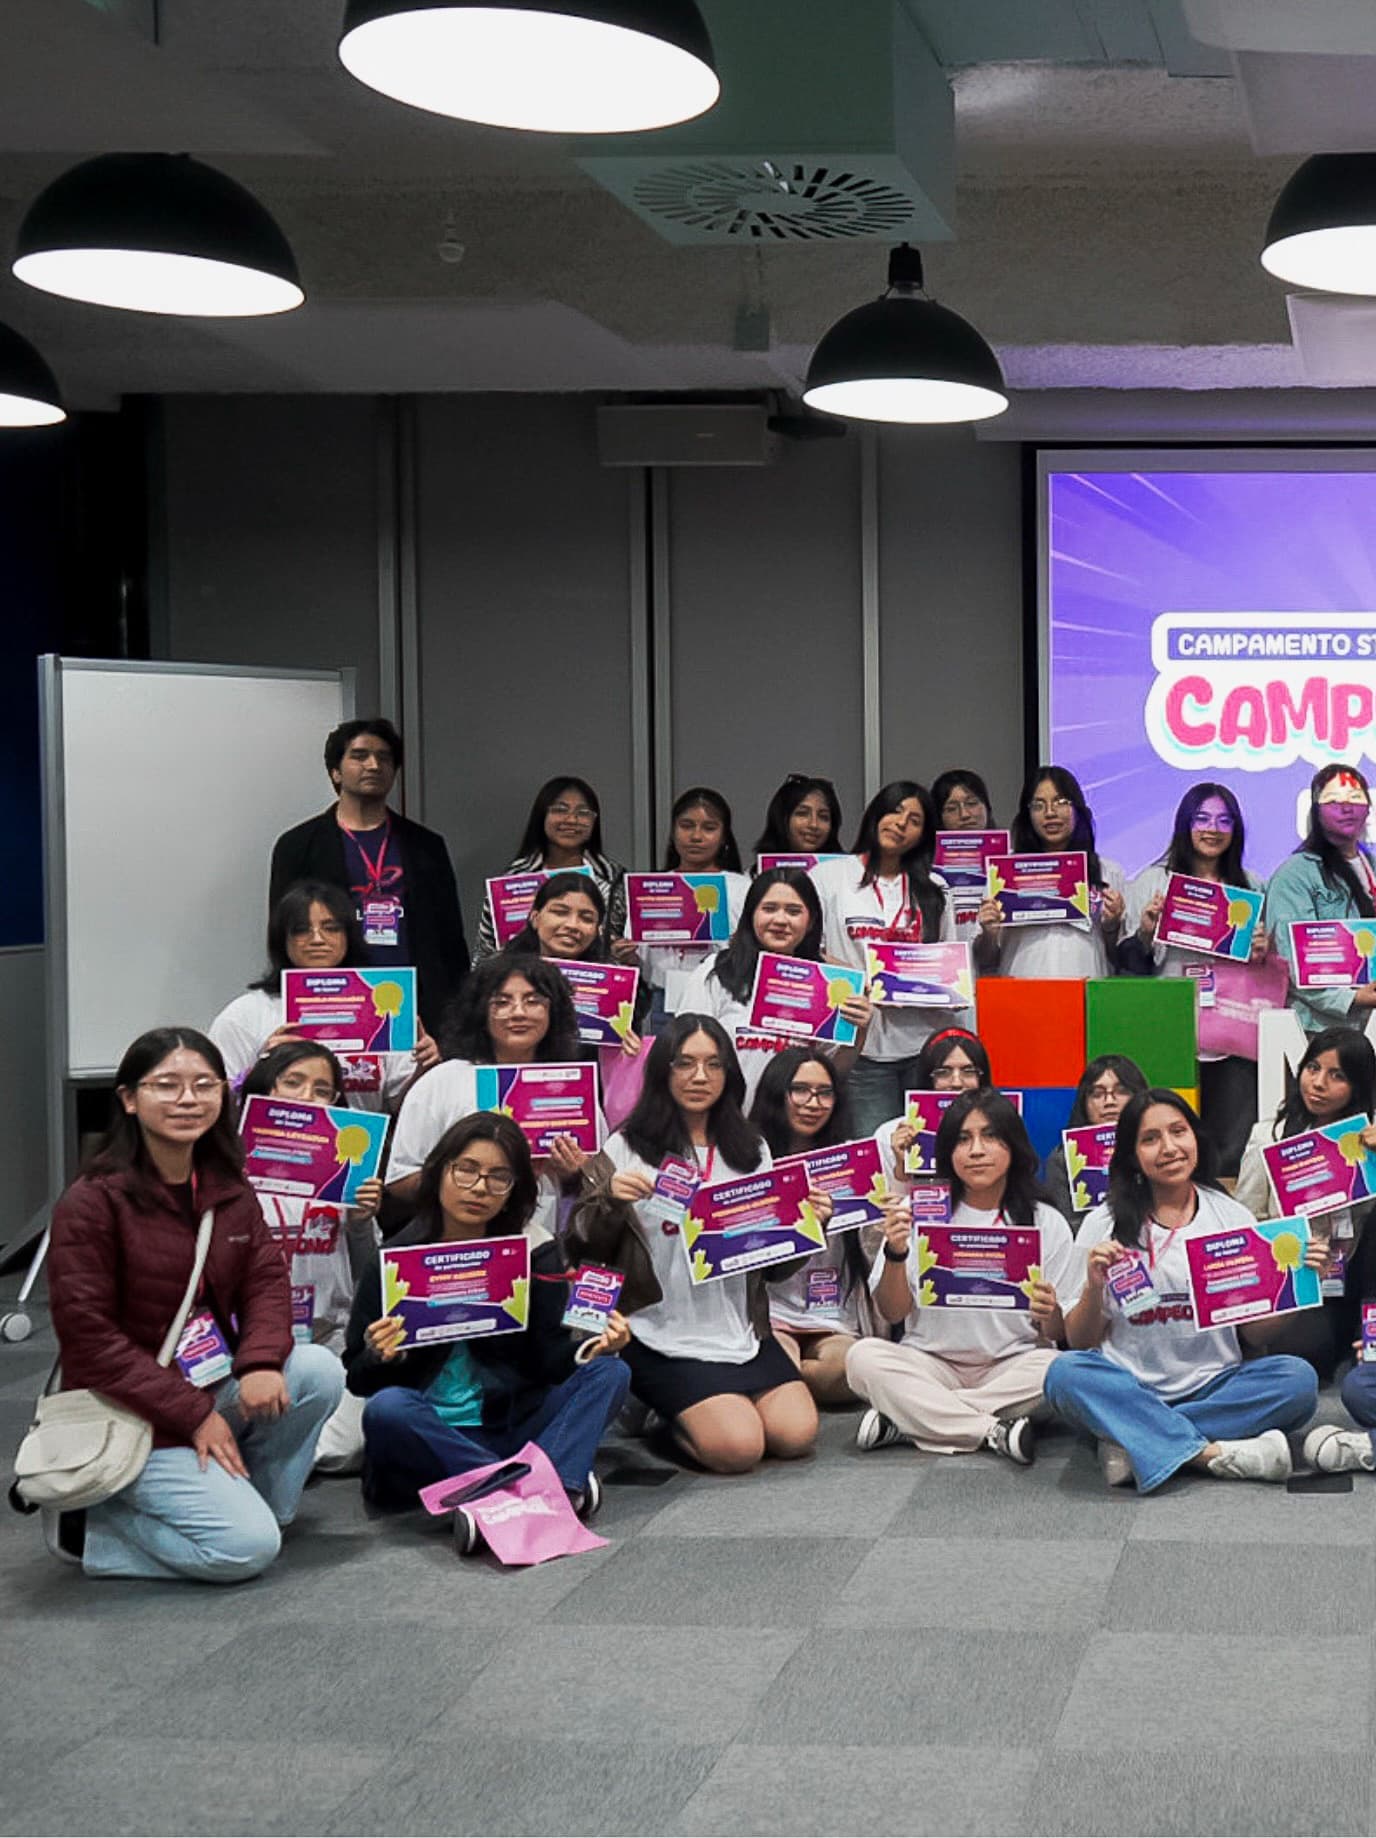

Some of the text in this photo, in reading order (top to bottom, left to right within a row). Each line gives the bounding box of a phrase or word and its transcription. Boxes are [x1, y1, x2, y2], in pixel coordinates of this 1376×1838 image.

[1177, 632, 1351, 657] CAMPAMENTO
[712, 1179, 773, 1201] CERTIFICADO
[424, 1250, 491, 1266] CERTIFICADO
